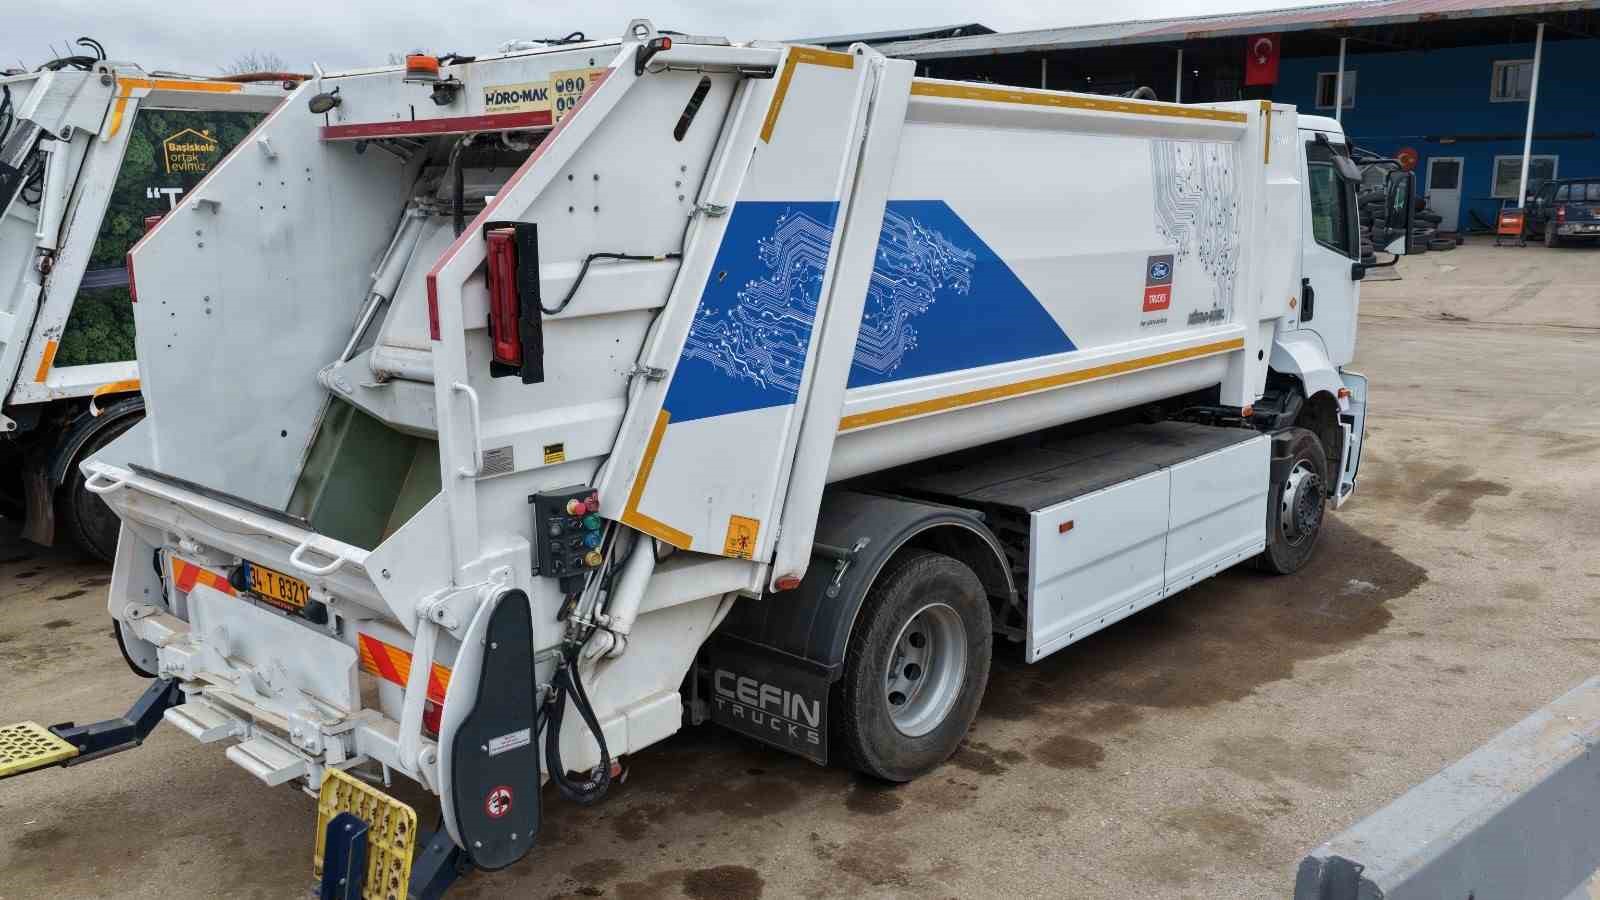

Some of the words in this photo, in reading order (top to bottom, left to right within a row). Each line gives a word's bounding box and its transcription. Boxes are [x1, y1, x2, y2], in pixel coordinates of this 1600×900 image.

[170, 152, 198, 162] ortak
[250, 567, 263, 592] 34
[267, 573, 273, 594] T
[714, 669, 820, 728] CEFIN
[714, 698, 820, 745] TRUCKS
